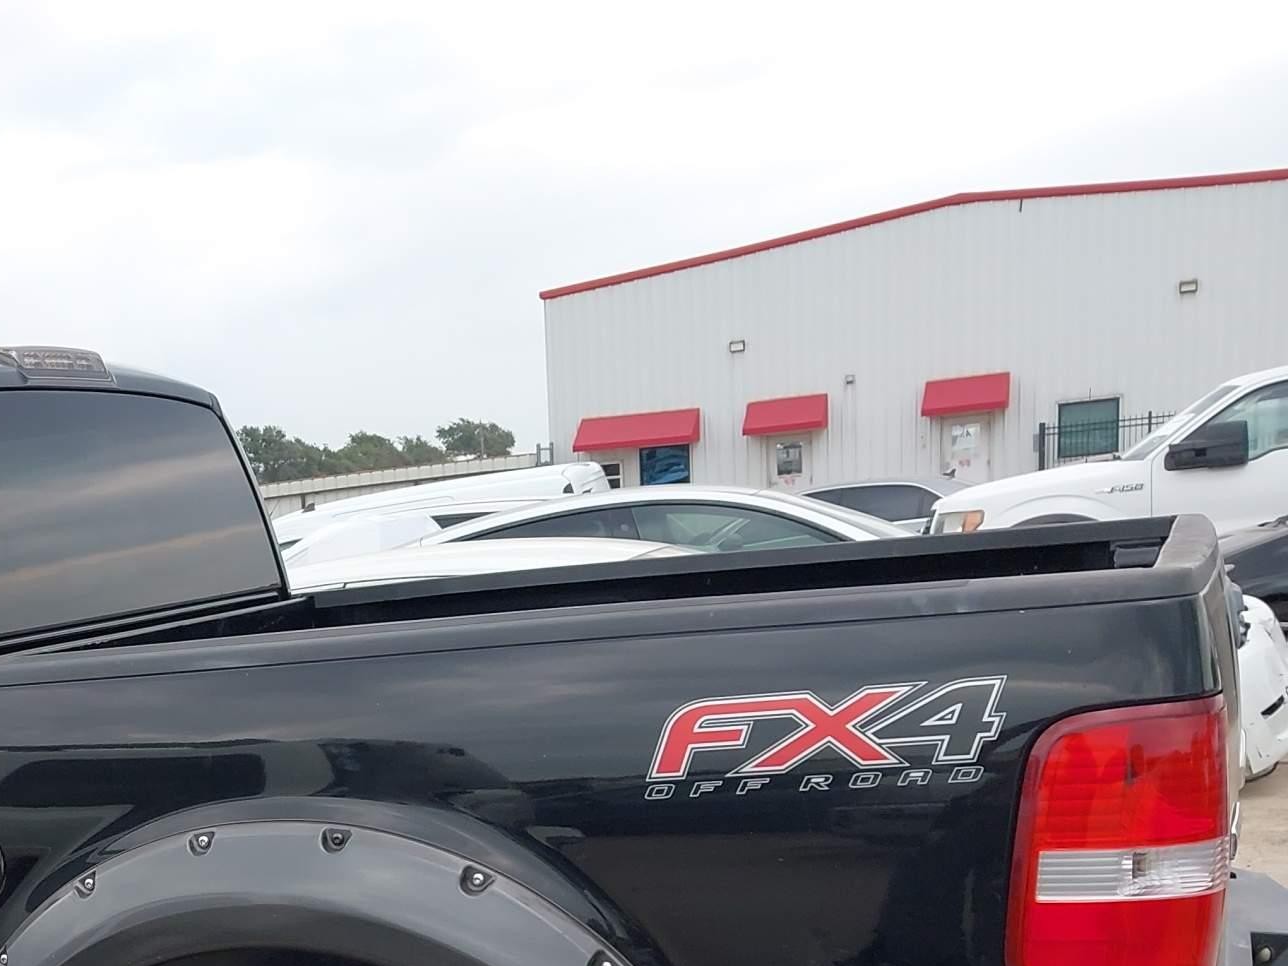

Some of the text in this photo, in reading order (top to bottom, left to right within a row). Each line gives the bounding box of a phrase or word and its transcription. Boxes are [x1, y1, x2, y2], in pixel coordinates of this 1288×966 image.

[646, 675, 1007, 782] FX4
[644, 765, 985, 800] OFF ROAD
